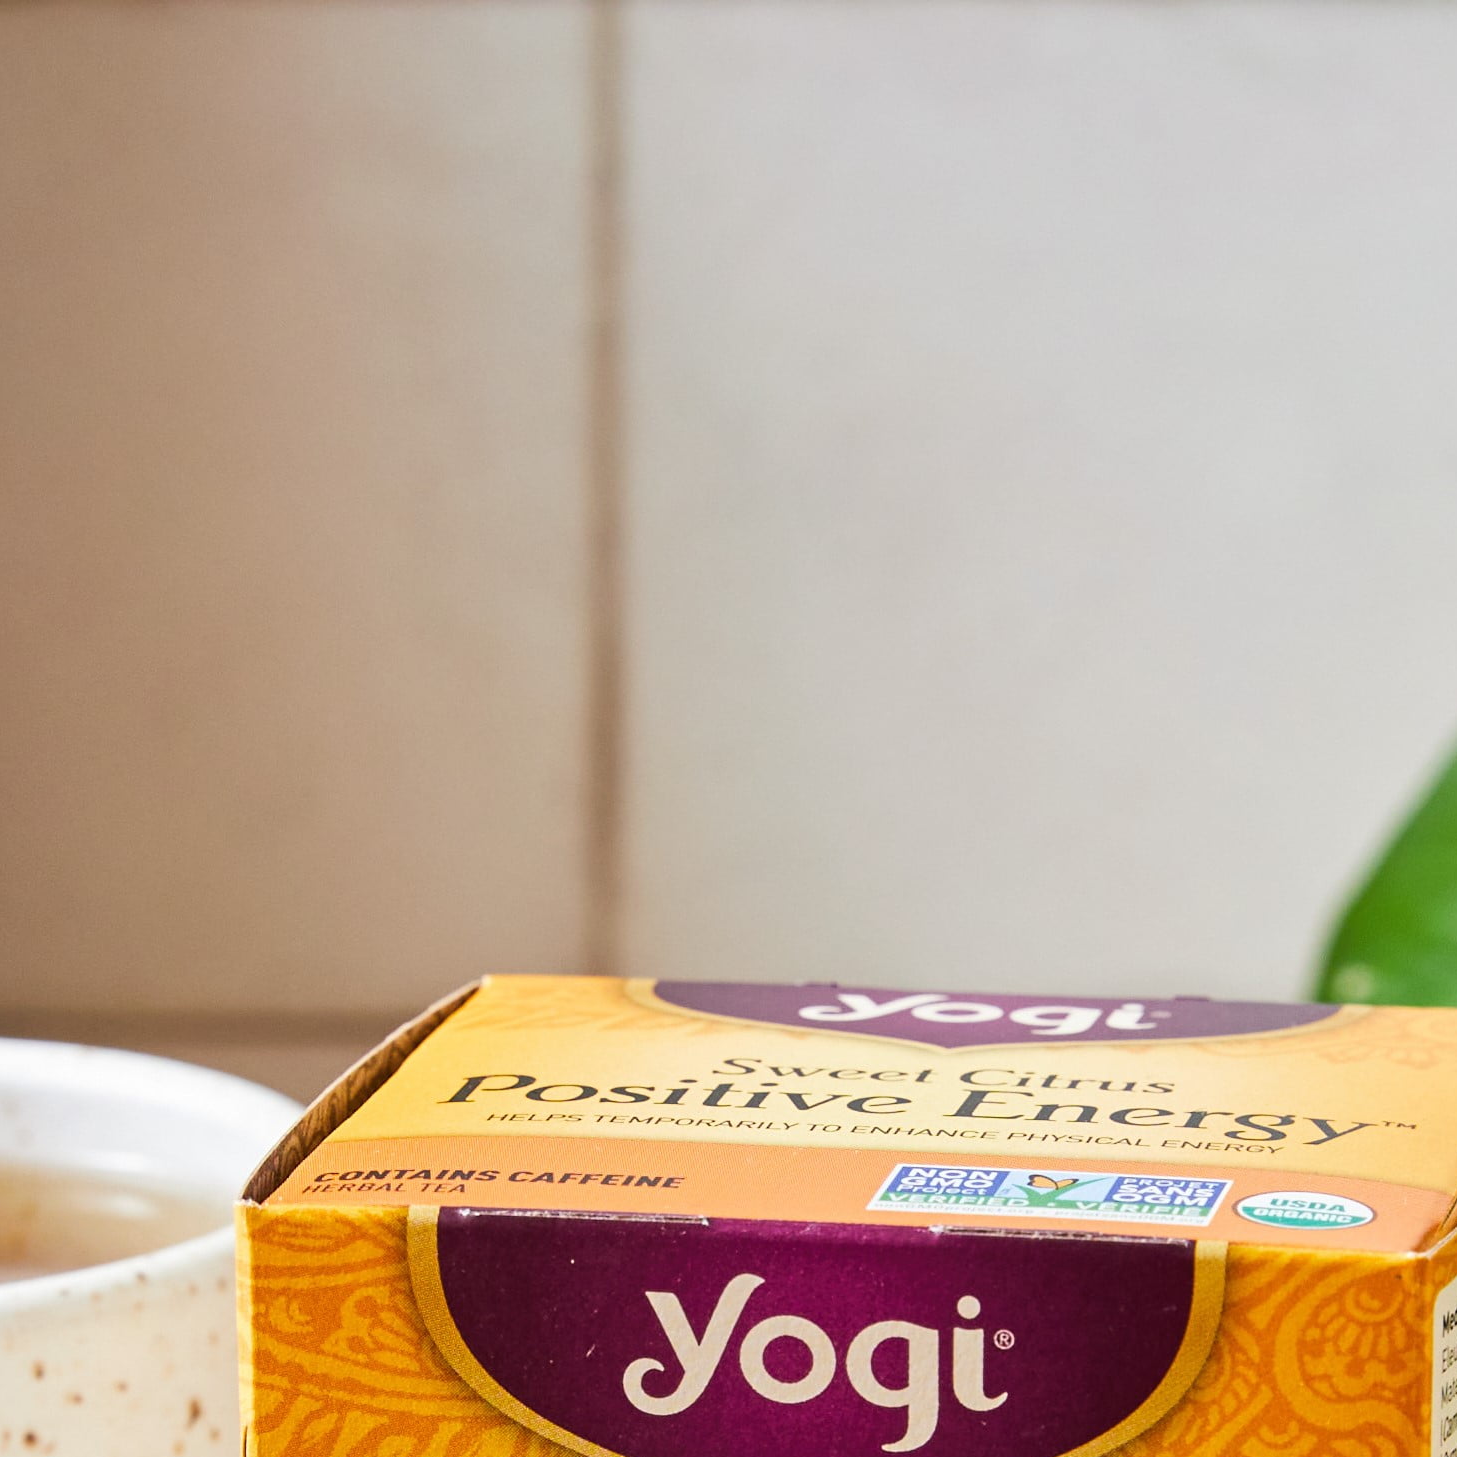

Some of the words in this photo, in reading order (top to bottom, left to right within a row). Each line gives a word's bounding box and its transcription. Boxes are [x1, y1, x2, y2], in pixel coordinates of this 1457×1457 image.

[713, 1057, 937, 1084] Sweet
[961, 1068, 1175, 1094] Citrus
[437, 1074, 913, 1114] Positive
[487, 1111, 586, 1124] HELPS
[591, 1115, 799, 1132] TEMPORARILY
[809, 1123, 845, 1134] TO
[850, 1125, 1002, 1141] ENHANCE
[1007, 1131, 1157, 1148] PHYSICAL
[1161, 1140, 1286, 1155] ENERGY
[313, 1168, 500, 1183] CONTAINS
[509, 1171, 686, 1189] CAFFEINE
[908, 1168, 998, 1180] NON
[303, 1182, 406, 1194] HERBAL
[420, 1183, 467, 1194] TEA
[901, 1177, 993, 1189] GMO
[1123, 1177, 1221, 1188] PROJET
[896, 1185, 988, 1196] Project
[1118, 1184, 1217, 1198] SANS
[888, 1193, 1030, 1206] VERIFIED
[1112, 1193, 1211, 1207] OGM
[1270, 1198, 1346, 1211] USDA
[1253, 1208, 1353, 1224] ORGANIC
